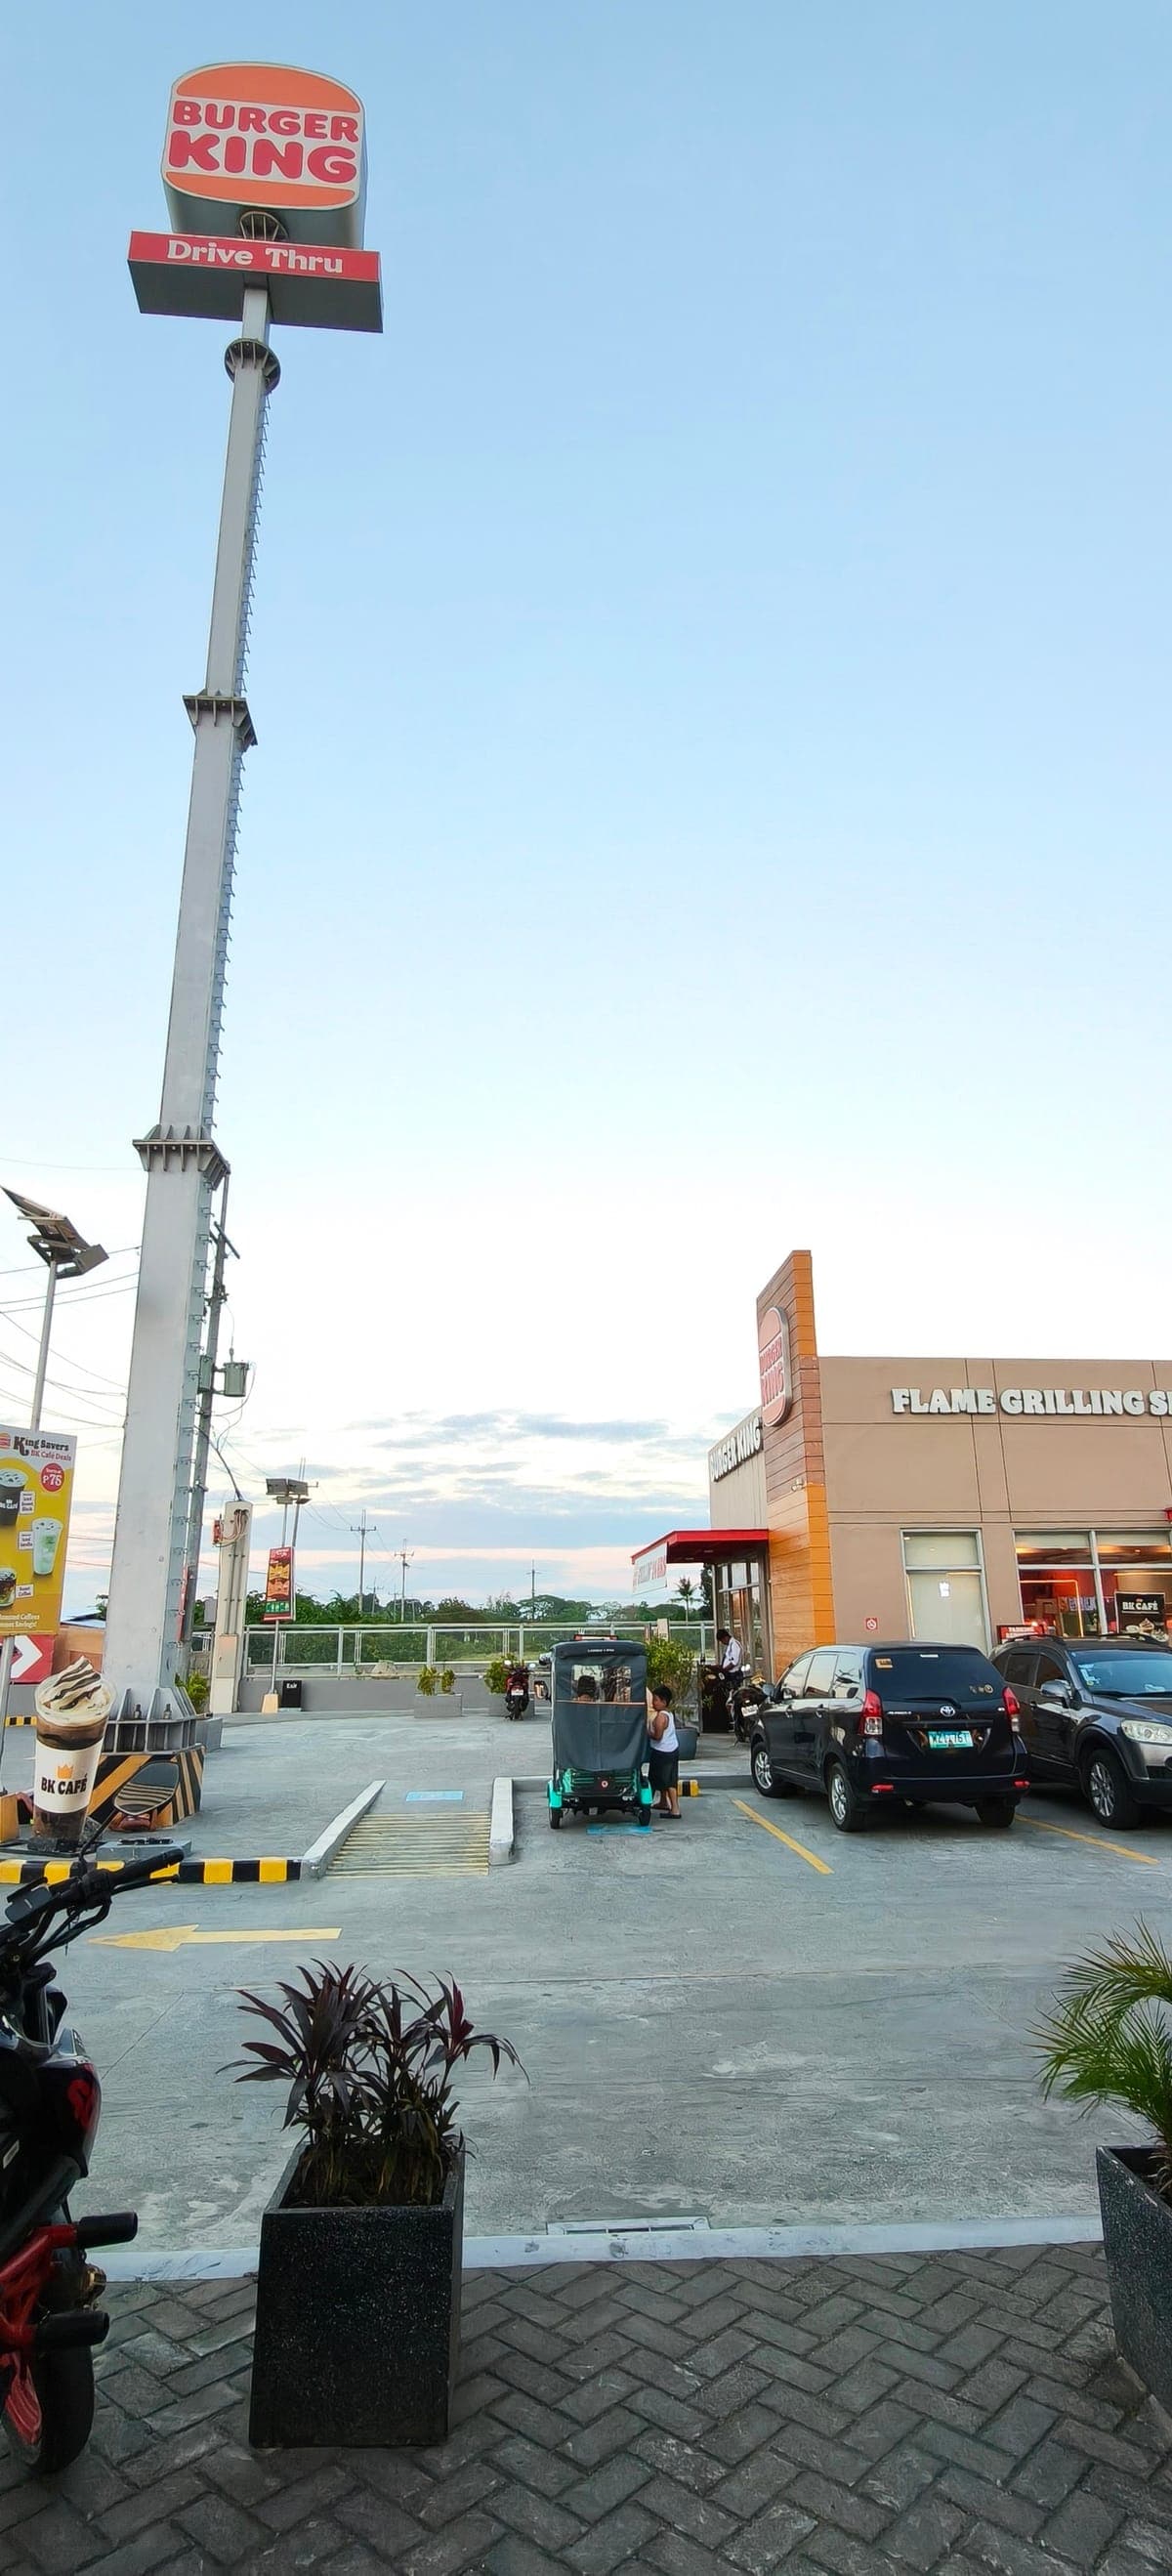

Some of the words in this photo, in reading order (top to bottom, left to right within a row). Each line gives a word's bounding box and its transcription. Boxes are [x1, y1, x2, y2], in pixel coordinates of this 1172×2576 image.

[172, 100, 359, 143] BURGER
[168, 130, 357, 184] KING
[167, 239, 254, 265] Drive
[266, 247, 343, 274] Thru
[891, 1388, 996, 1414] FLAME
[999, 1389, 1146, 1415] GRILLING
[1149, 1390, 1172, 1415] S
[14, 1436, 39, 1456] King
[40, 1439, 69, 1452] Savers
[710, 1437, 737, 1483] BURGER
[736, 1416, 761, 1462] KING
[1122, 1601, 1135, 1611] BK
[1135, 1599, 1158, 1611] CAFÉ
[41, 1777, 56, 1795] BK
[58, 1772, 88, 1795] CAFÉ
